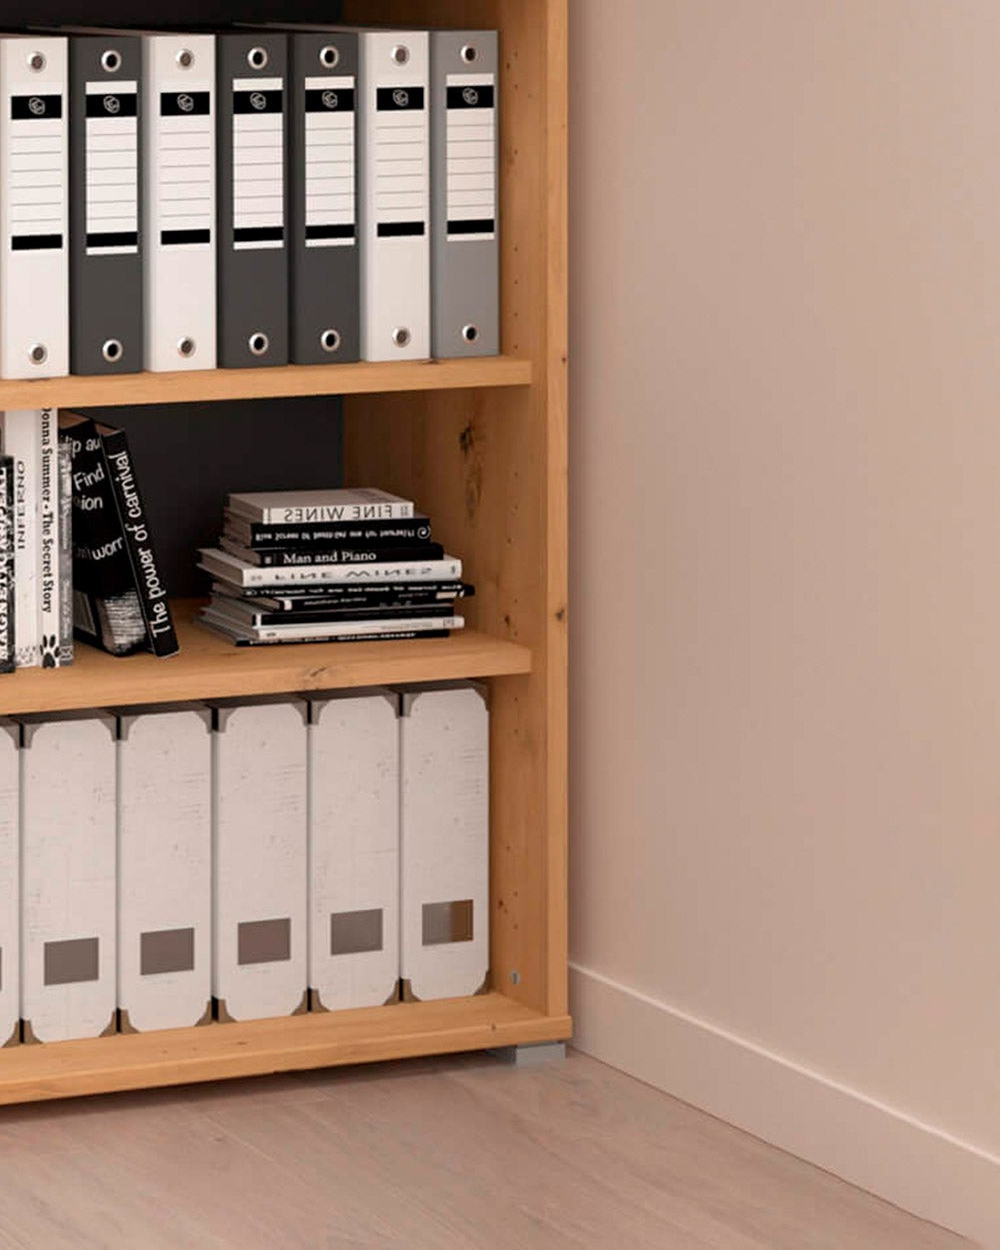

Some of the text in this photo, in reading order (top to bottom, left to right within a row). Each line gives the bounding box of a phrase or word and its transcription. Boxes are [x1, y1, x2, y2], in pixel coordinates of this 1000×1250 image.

[42, 448, 53, 502] Summer
[73, 462, 104, 491] Find
[17, 461, 25, 551] INFERNO
[43, 512, 54, 536] The
[43, 538, 53, 579] Secret
[107, 451, 170, 637] The power of carnival
[283, 551, 376, 564] Man and Piano
[37, 580, 54, 613] Story
